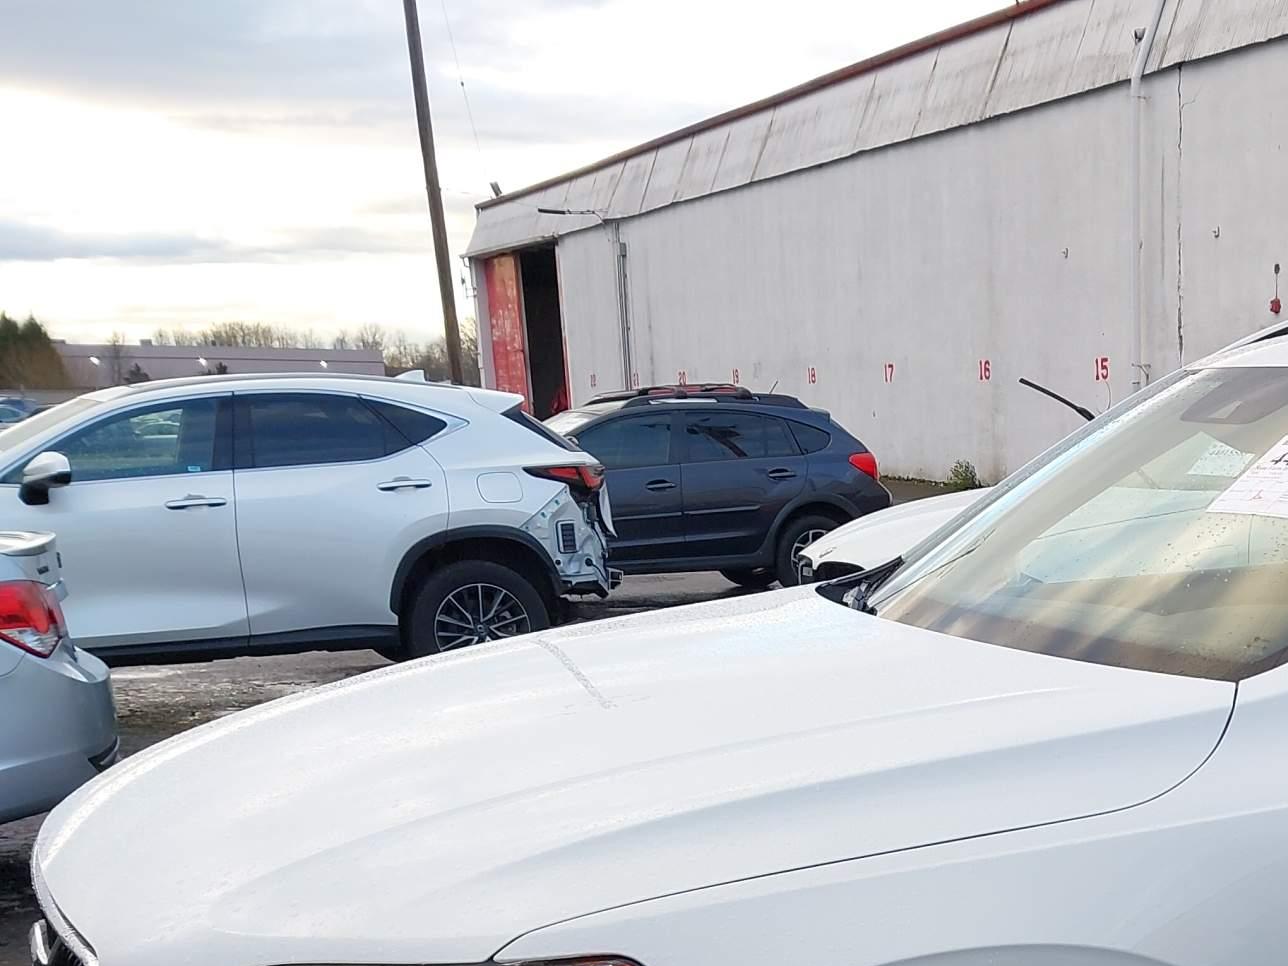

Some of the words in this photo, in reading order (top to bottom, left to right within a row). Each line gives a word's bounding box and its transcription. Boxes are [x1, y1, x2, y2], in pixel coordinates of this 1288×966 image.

[732, 368, 739, 385] 19
[807, 367, 817, 385] 18
[884, 363, 894, 383] 17
[979, 359, 991, 381] 16
[1095, 357, 1109, 381] 15
